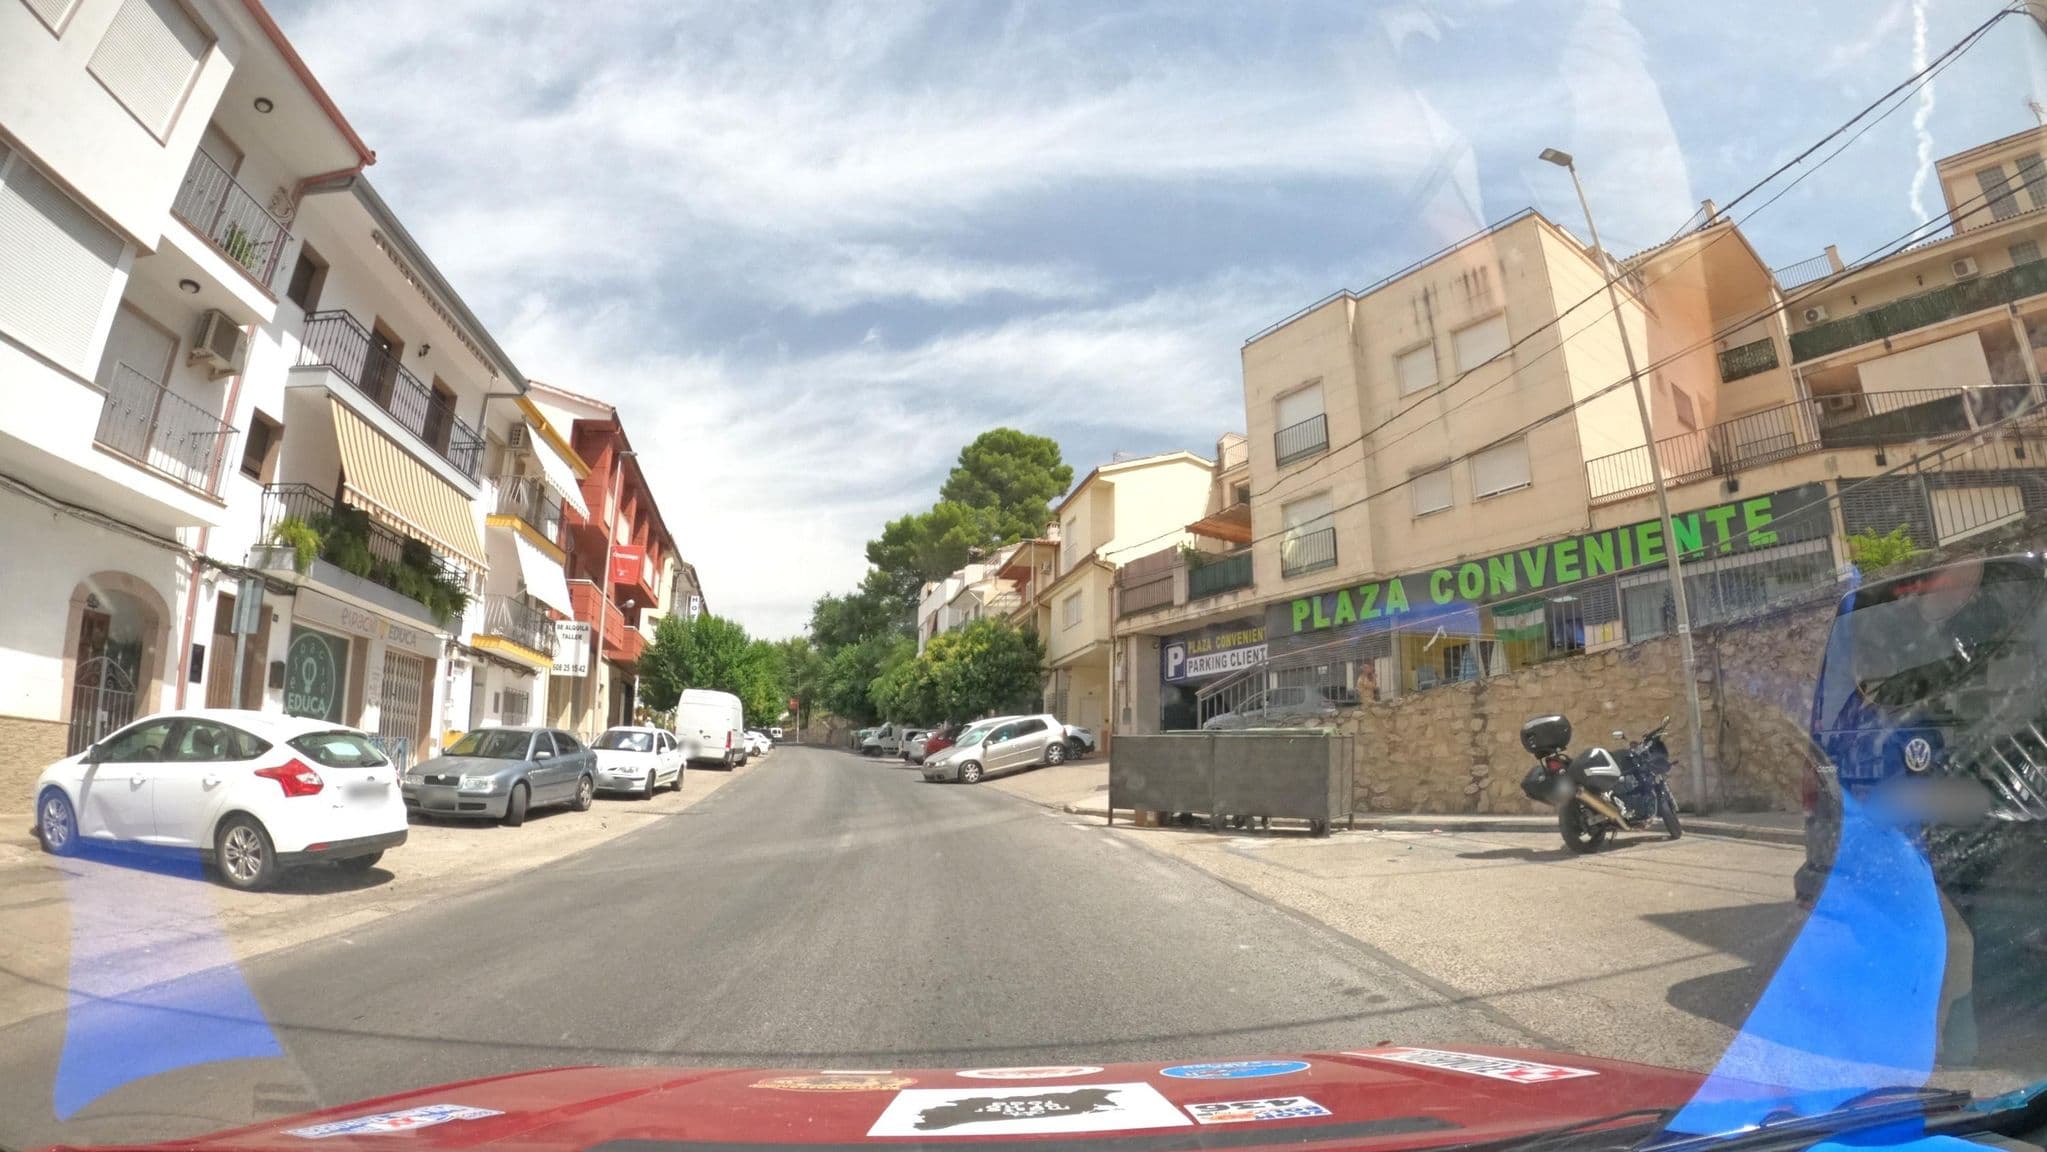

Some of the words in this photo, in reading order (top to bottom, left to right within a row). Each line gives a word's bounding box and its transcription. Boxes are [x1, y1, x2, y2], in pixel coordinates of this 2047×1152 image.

[1291, 578, 1410, 633] PLAZA
[1430, 496, 1778, 605] CONVENIENTE
[388, 623, 417, 648] EDUCA
[1187, 638, 1212, 655] PLAZA
[1168, 645, 1184, 678] P
[1188, 654, 1227, 674] PARKING
[287, 691, 327, 714] EDUCA
